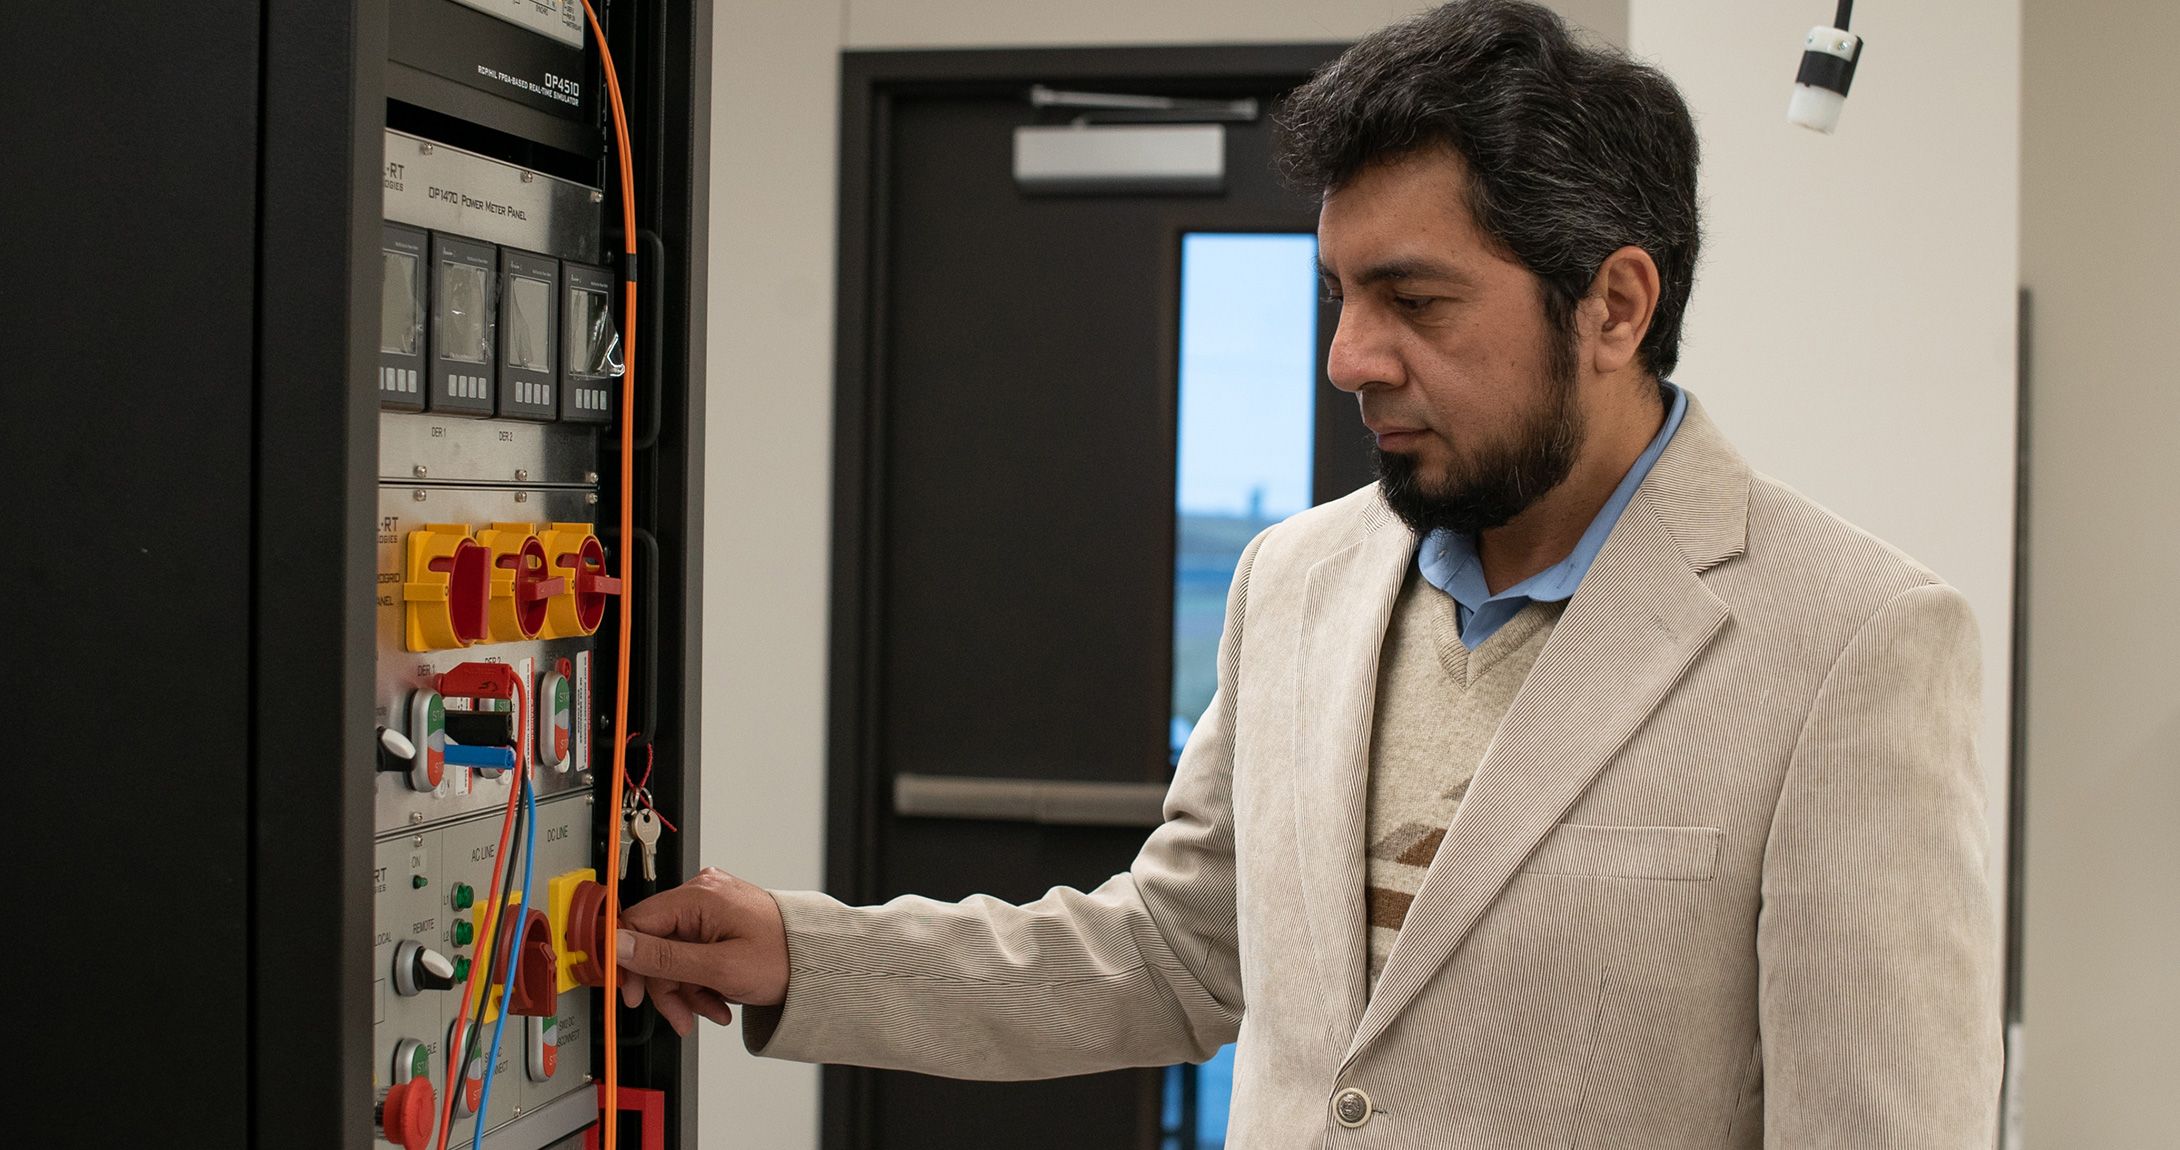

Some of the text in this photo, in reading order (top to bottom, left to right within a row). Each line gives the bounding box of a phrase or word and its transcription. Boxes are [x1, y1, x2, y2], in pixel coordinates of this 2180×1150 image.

[498, 72, 528, 89] FPGA-BASED
[545, 72, 580, 97] OP4510
[428, 186, 459, 204] OP1470
[431, 426, 447, 437] DER 1
[499, 431, 513, 441] DER 2
[417, 664, 436, 677] DER 1
[547, 824, 568, 842] DC LINE
[471, 844, 495, 862] AC LINE
[412, 918, 434, 935] REMOTE
